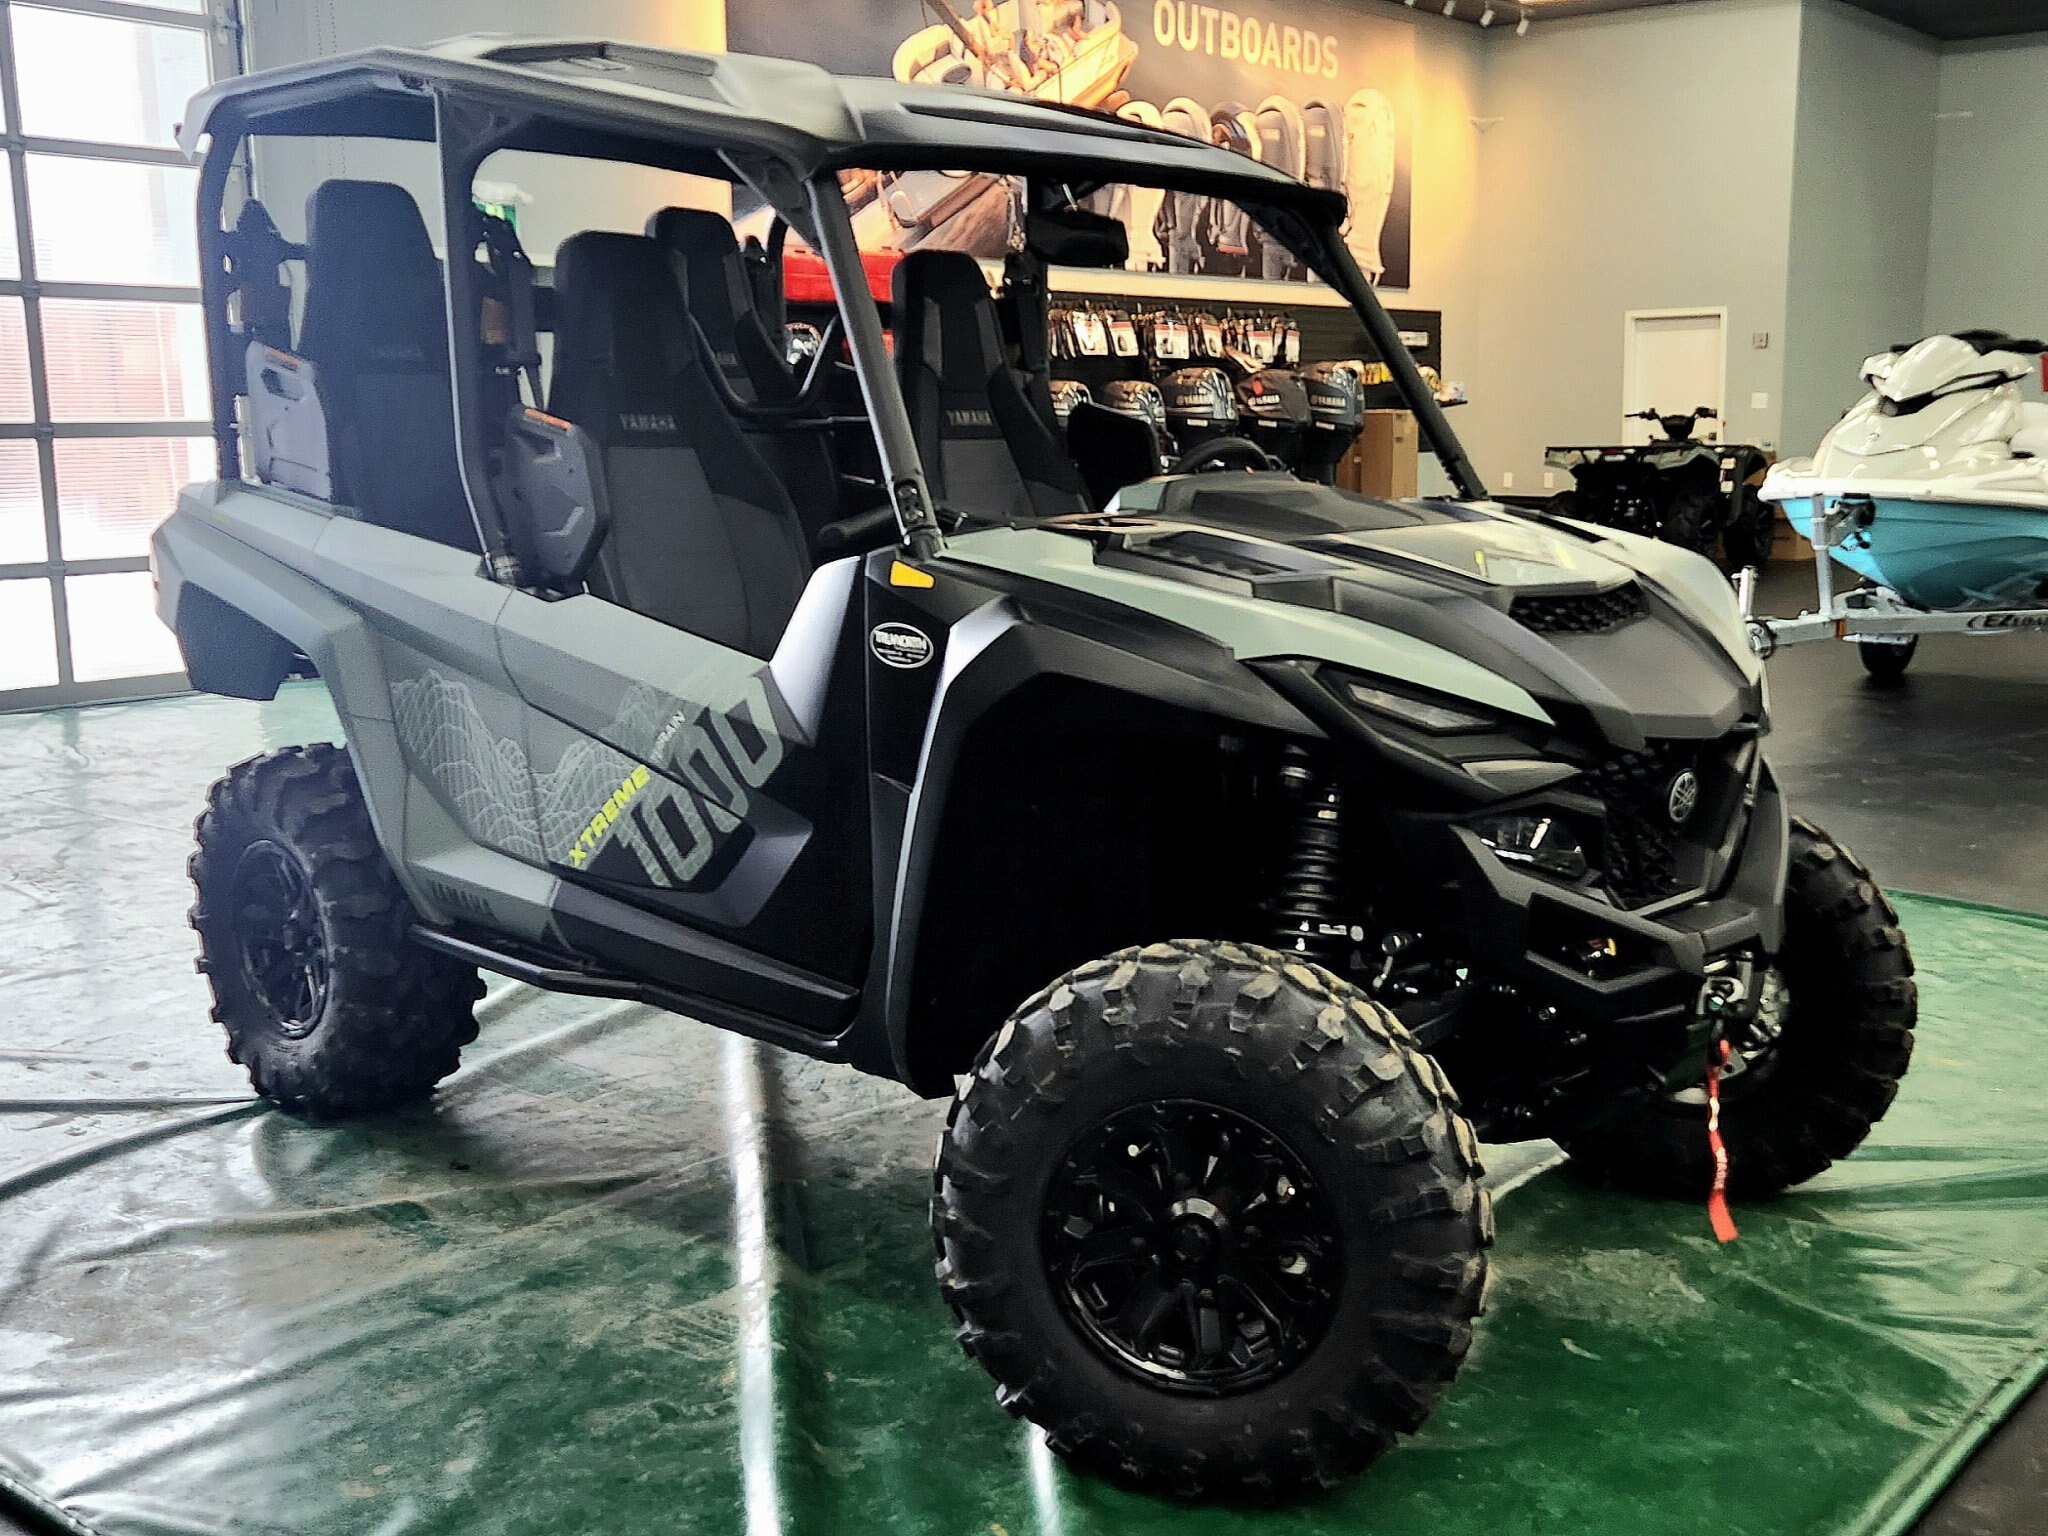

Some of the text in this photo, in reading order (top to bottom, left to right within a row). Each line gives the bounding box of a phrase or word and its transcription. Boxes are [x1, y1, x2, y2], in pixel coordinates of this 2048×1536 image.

[1153, 0, 1338, 79] OUTBOARDS
[618, 412, 678, 432] YAMAHA
[945, 409, 992, 427] YAMAHA
[568, 764, 651, 867] XTREME
[613, 674, 784, 889] 1000
